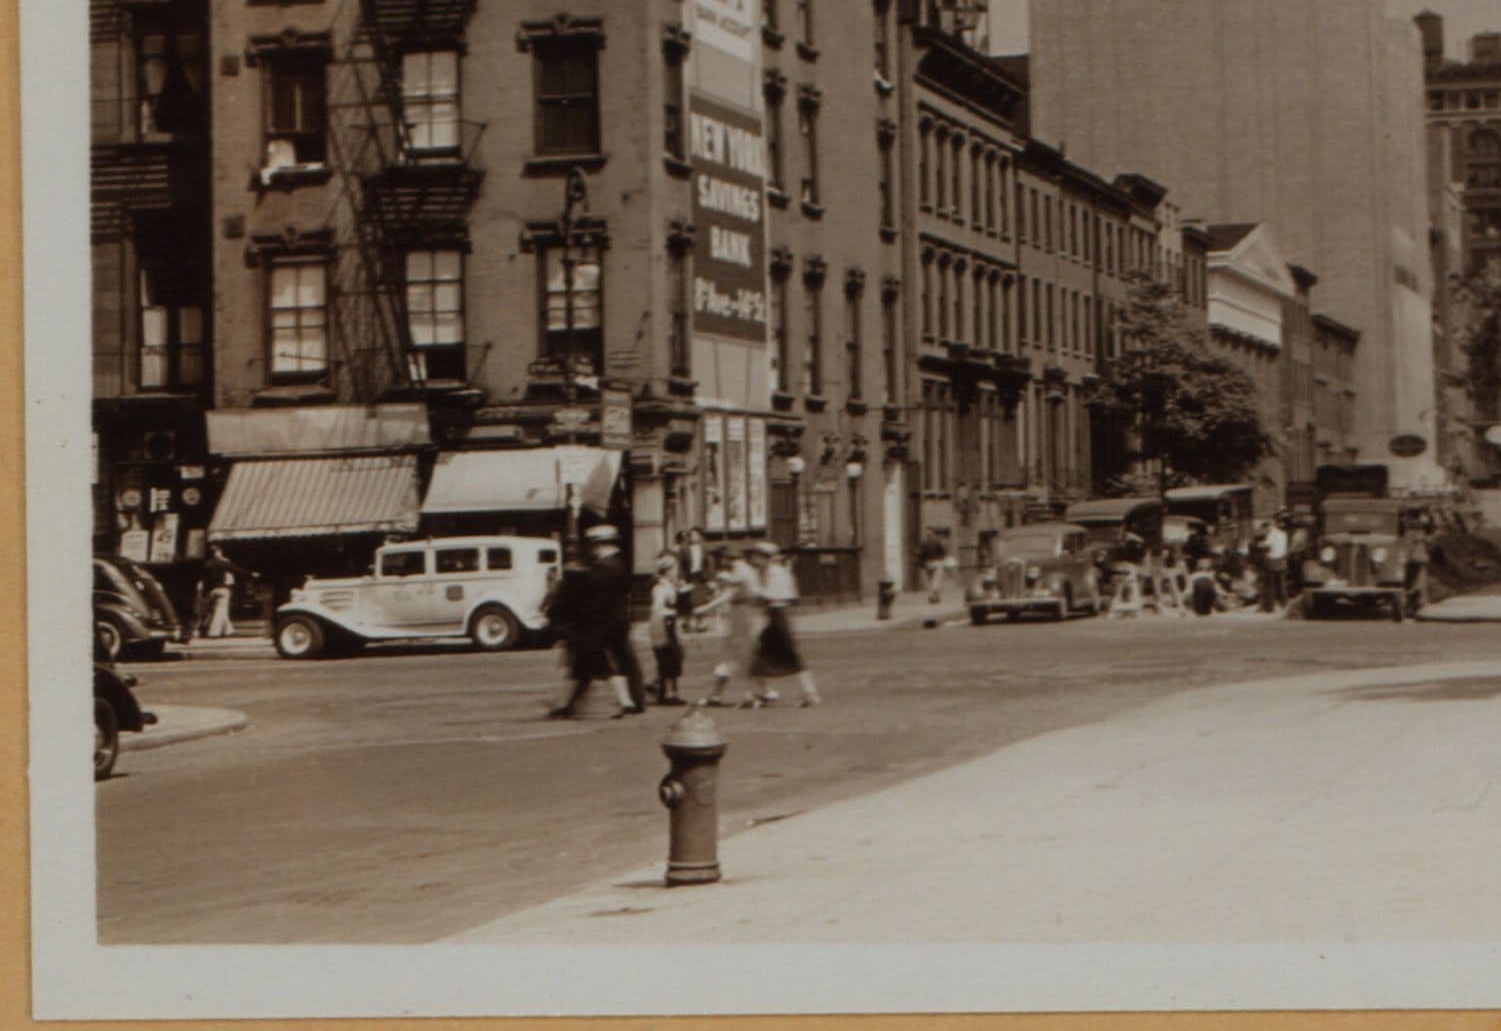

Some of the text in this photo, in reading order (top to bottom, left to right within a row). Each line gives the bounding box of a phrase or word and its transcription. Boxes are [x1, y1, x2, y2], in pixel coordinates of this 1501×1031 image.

[691, 112, 763, 178] NEW YORK
[697, 173, 760, 222] SAVINGS
[710, 224, 752, 268] BANK
